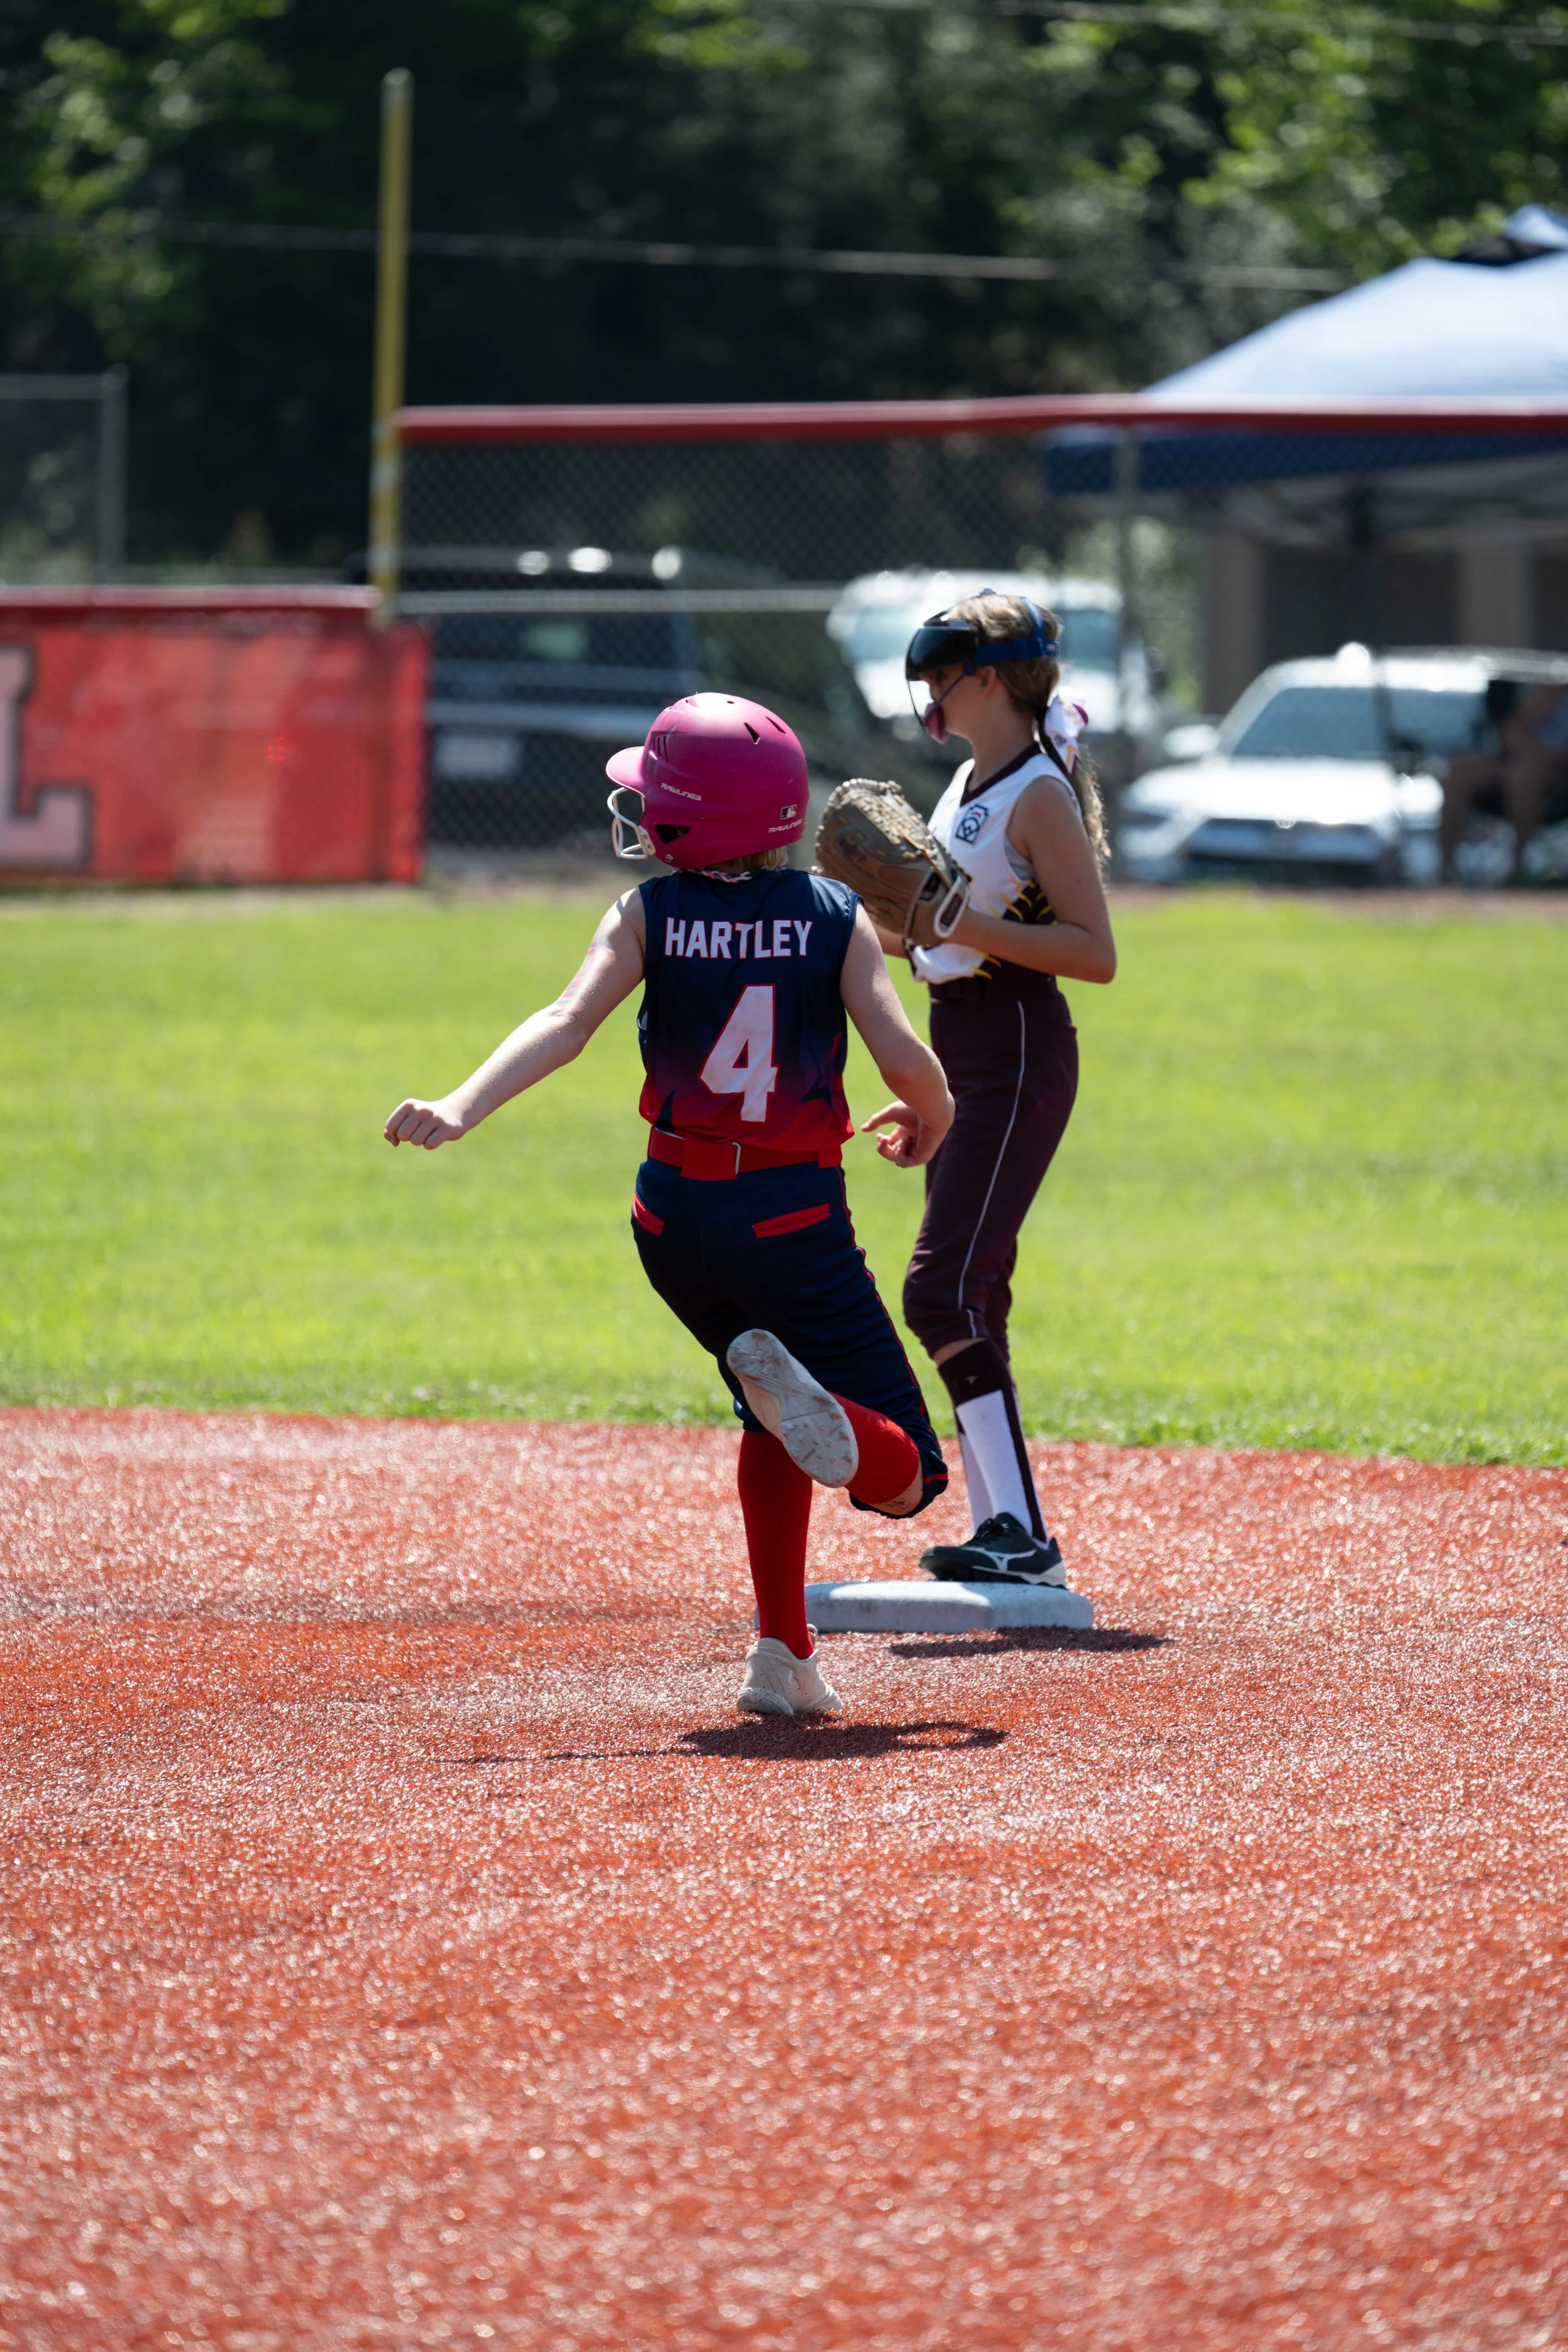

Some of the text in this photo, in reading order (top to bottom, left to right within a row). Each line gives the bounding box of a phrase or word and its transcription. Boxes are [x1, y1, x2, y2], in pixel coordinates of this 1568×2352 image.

[660, 782, 702, 802] RAWLINGS
[665, 917, 813, 959] HARTLEY
[699, 984, 780, 1122] 4
